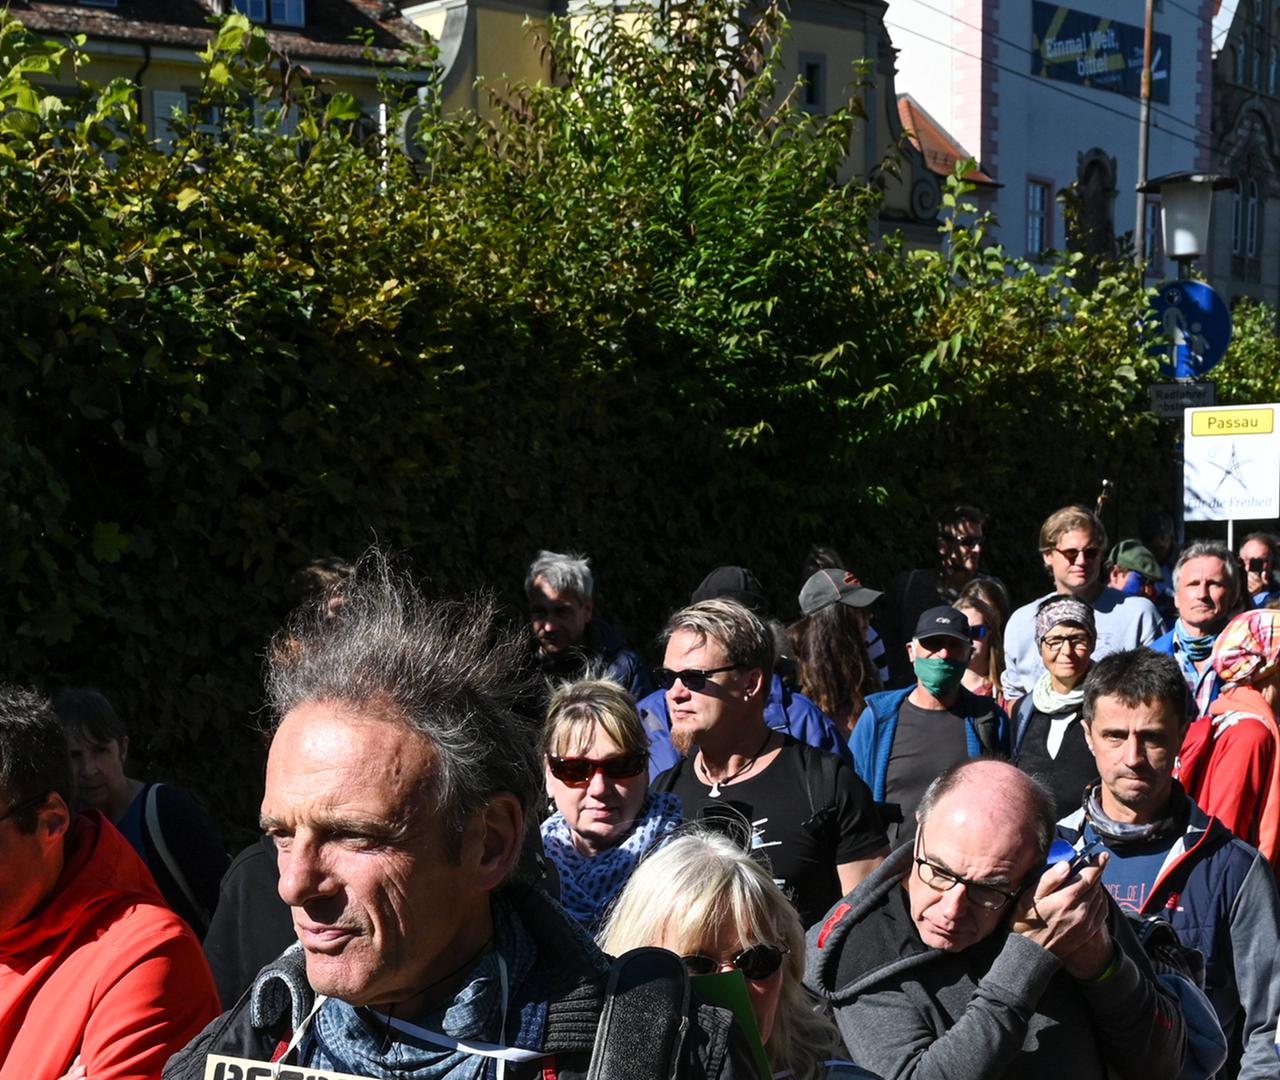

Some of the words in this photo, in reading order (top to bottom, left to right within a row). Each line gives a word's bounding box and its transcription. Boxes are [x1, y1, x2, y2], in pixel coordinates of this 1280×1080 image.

[1045, 32, 1087, 60] Einmal
[1208, 416, 1258, 429] Passau
[1229, 496, 1273, 510] Freiheit
